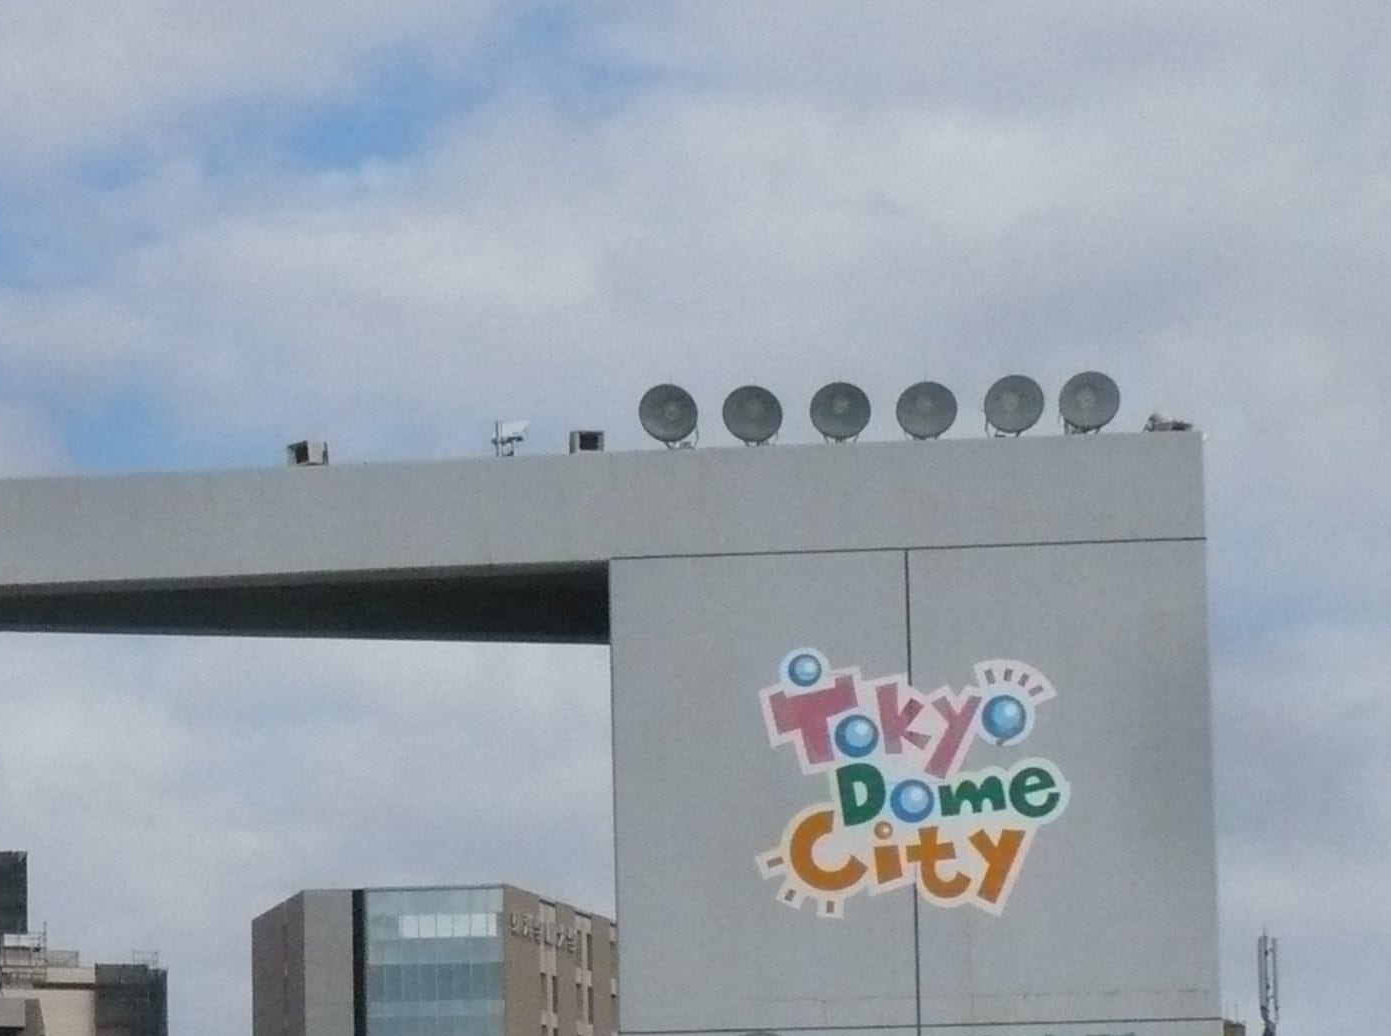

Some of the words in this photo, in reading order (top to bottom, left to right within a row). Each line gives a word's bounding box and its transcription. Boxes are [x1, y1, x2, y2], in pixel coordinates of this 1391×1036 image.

[765, 670, 1030, 780] Tokyo
[835, 762, 1061, 827] Dome
[788, 810, 1027, 905] City
